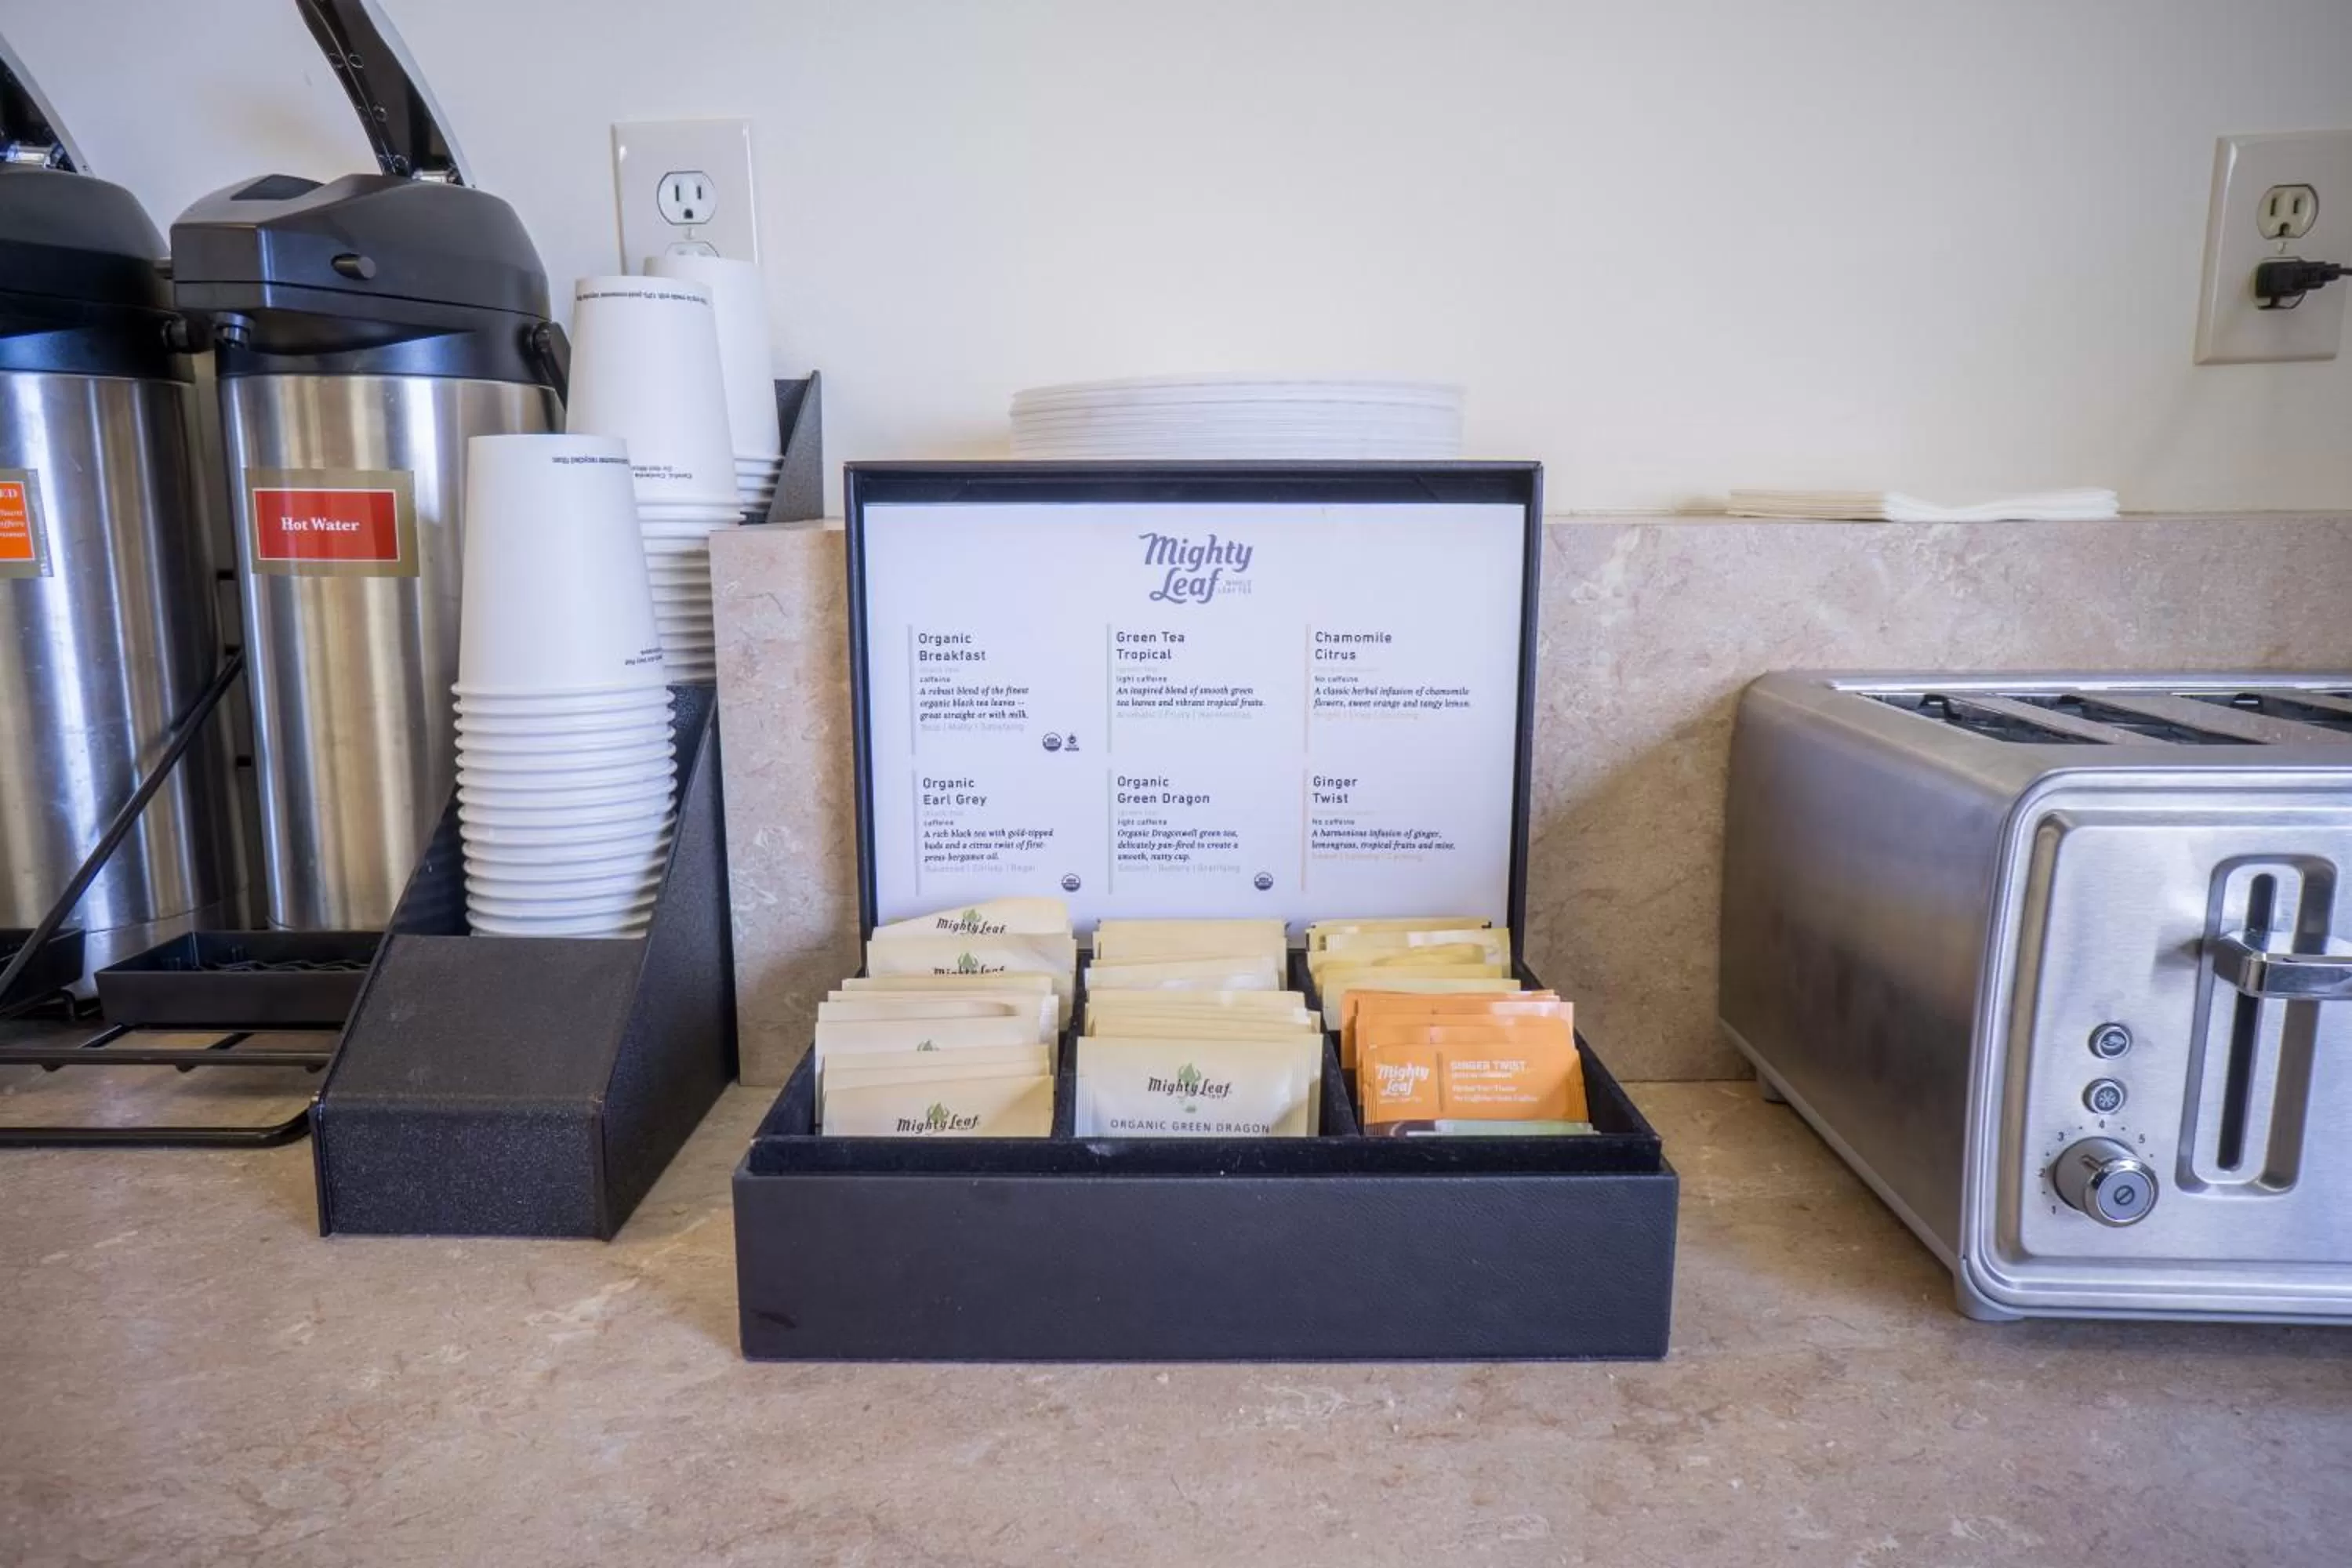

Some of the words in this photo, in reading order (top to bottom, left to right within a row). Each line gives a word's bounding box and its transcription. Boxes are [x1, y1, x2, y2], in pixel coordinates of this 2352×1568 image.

[281, 517, 308, 532] Hot
[311, 517, 359, 532] Water
[1138, 533, 1253, 572] Mighty
[1149, 567, 1223, 604] Leaf
[918, 633, 972, 646] Organic
[1116, 631, 1156, 643] Green
[1161, 631, 1185, 643] Tea
[1315, 631, 1392, 643] Chamomile
[919, 650, 985, 661] Breakfast
[1116, 649, 1171, 662] Tropical
[1315, 649, 1356, 660] Citrus
[956, 687, 978, 695] blend
[981, 687, 990, 696] of
[992, 686, 1004, 695] the
[1005, 687, 1029, 696] finest
[1131, 687, 1163, 696] inspired
[1189, 686, 1198, 696] of
[1230, 688, 1253, 696] green
[1380, 687, 1413, 696] infusion
[1416, 687, 1423, 696] of
[920, 699, 950, 709] organic
[953, 699, 974, 707] black
[1207, 698, 1238, 709] tropical
[1314, 699, 1345, 709] flowers,
[1420, 700, 1442, 709] tangy
[920, 712, 942, 721] great
[944, 712, 975, 721] straight
[989, 710, 1006, 719] with
[1008, 710, 1029, 719] milk.
[923, 778, 975, 790] Organic
[1117, 776, 1169, 789] Organic
[1313, 776, 1358, 789] Ginger
[924, 795, 950, 804] Earl
[956, 795, 986, 807] Grey
[1117, 793, 1156, 804] Green
[1163, 793, 1210, 806] Dragon
[1312, 793, 1348, 803] Twist
[1118, 829, 1149, 839] Organic
[1152, 829, 1197, 839] Dragonwell
[1370, 829, 1401, 838] infusion
[1403, 829, 1412, 839] of
[924, 841, 943, 850] buds
[1016, 841, 1025, 850] of
[1118, 841, 1155, 850] delicately
[1157, 841, 1196, 850] pan-fired
[1312, 841, 1358, 850] lemongrass,
[1360, 841, 1391, 850] tropical
[1393, 841, 1416, 850] fruits
[924, 854, 946, 862] press
[948, 853, 984, 862] bergamot
[935, 918, 979, 934] Mighty
[980, 921, 1005, 934] Leaf
[1377, 1062, 1429, 1082] Mighty
[1148, 1077, 1198, 1096] Mighty
[1199, 1079, 1231, 1098] Leaf
[1381, 1079, 1415, 1097] Leaf
[896, 1118, 949, 1134] Mighty
[949, 1113, 978, 1130] Leaf
[1110, 1119, 1167, 1130] ORGANIC
[1172, 1122, 1210, 1131] GREEN
[1216, 1123, 1269, 1133] DRAGON
[2099, 1120, 2105, 1129] 4
[2058, 1131, 2064, 1142] 3
[2139, 1134, 2145, 1144] 5
[2038, 1168, 2046, 1178] 2
[2052, 1206, 2056, 1214] 1
